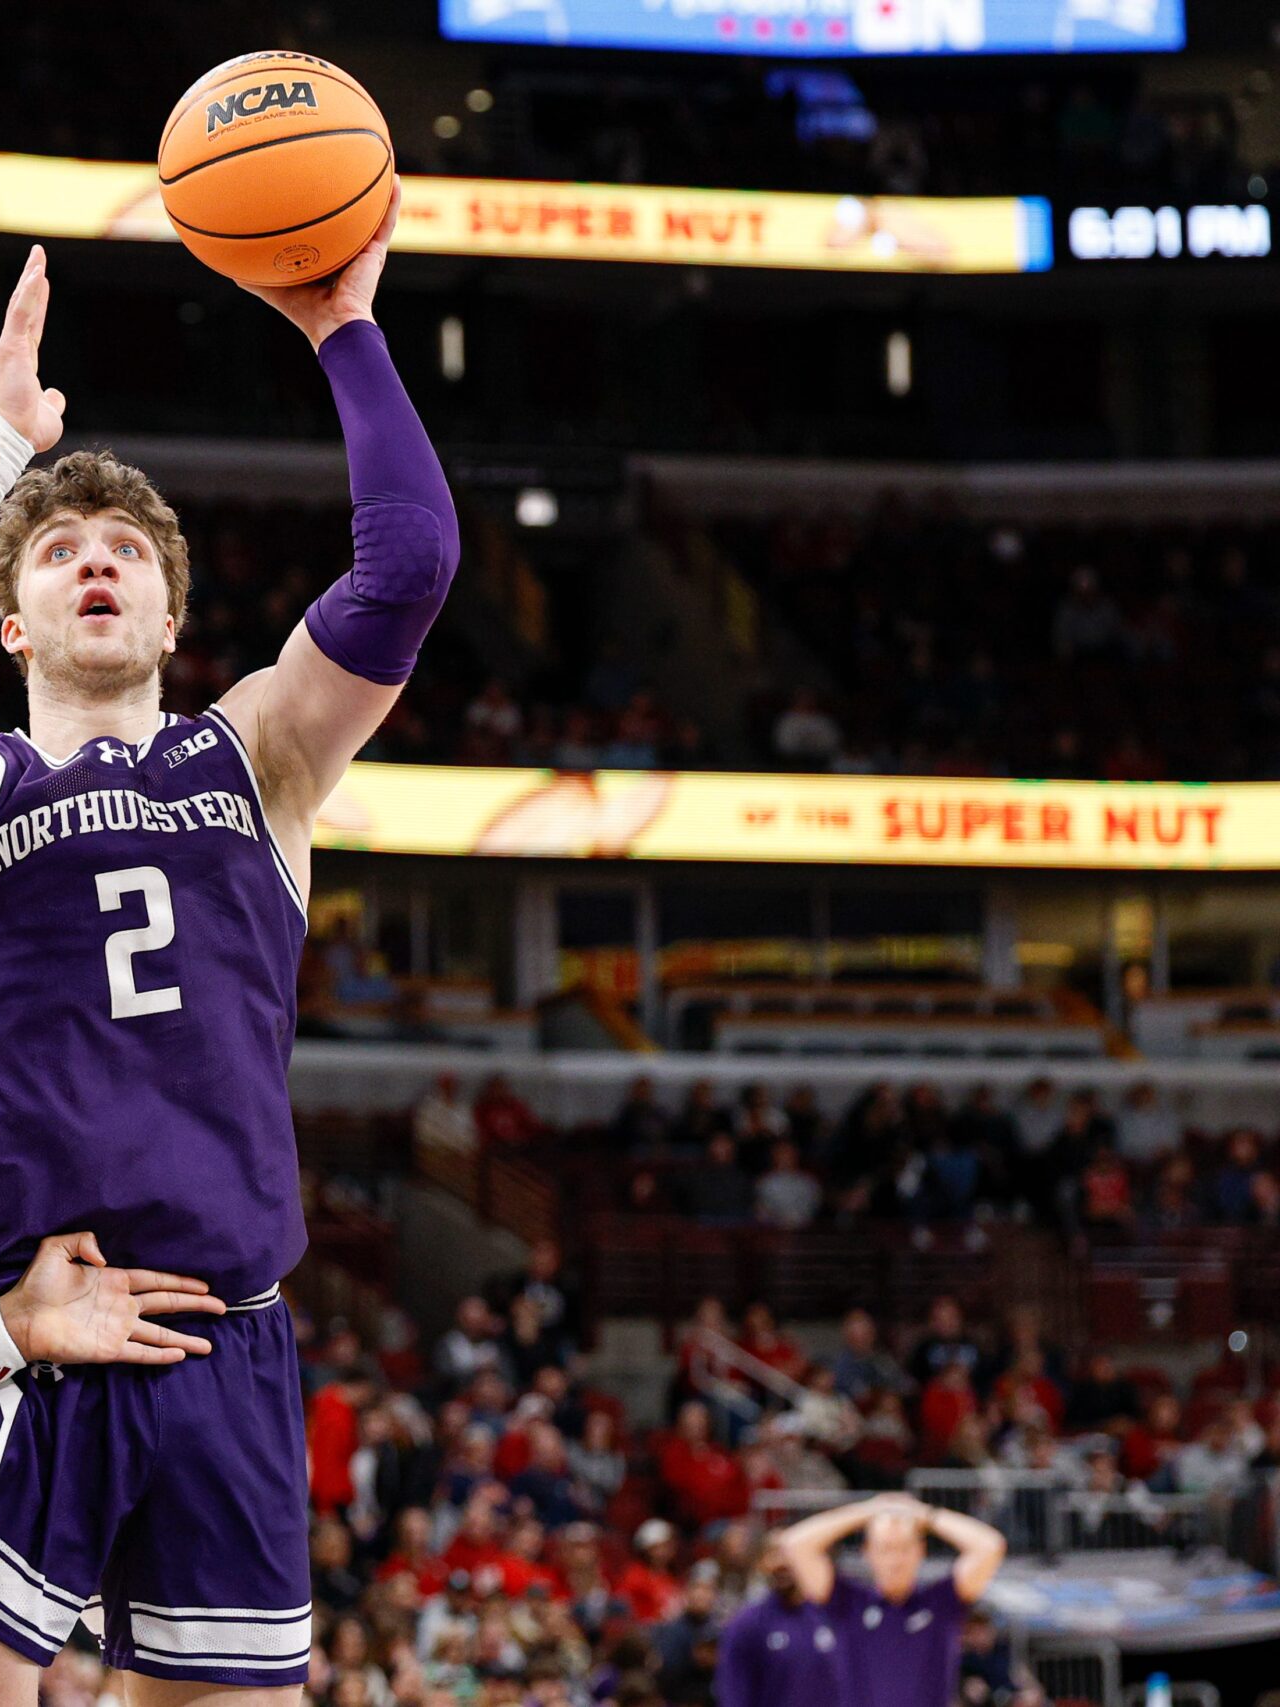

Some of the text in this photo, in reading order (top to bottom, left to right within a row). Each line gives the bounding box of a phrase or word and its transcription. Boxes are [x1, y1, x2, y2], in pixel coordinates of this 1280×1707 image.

[206, 81, 317, 133] NCAA
[468, 199, 634, 237] SUPER
[663, 210, 763, 245] NUT
[884, 801, 1071, 841] SUPER
[1103, 806, 1224, 845] NUT
[94, 866, 182, 1019] 2
